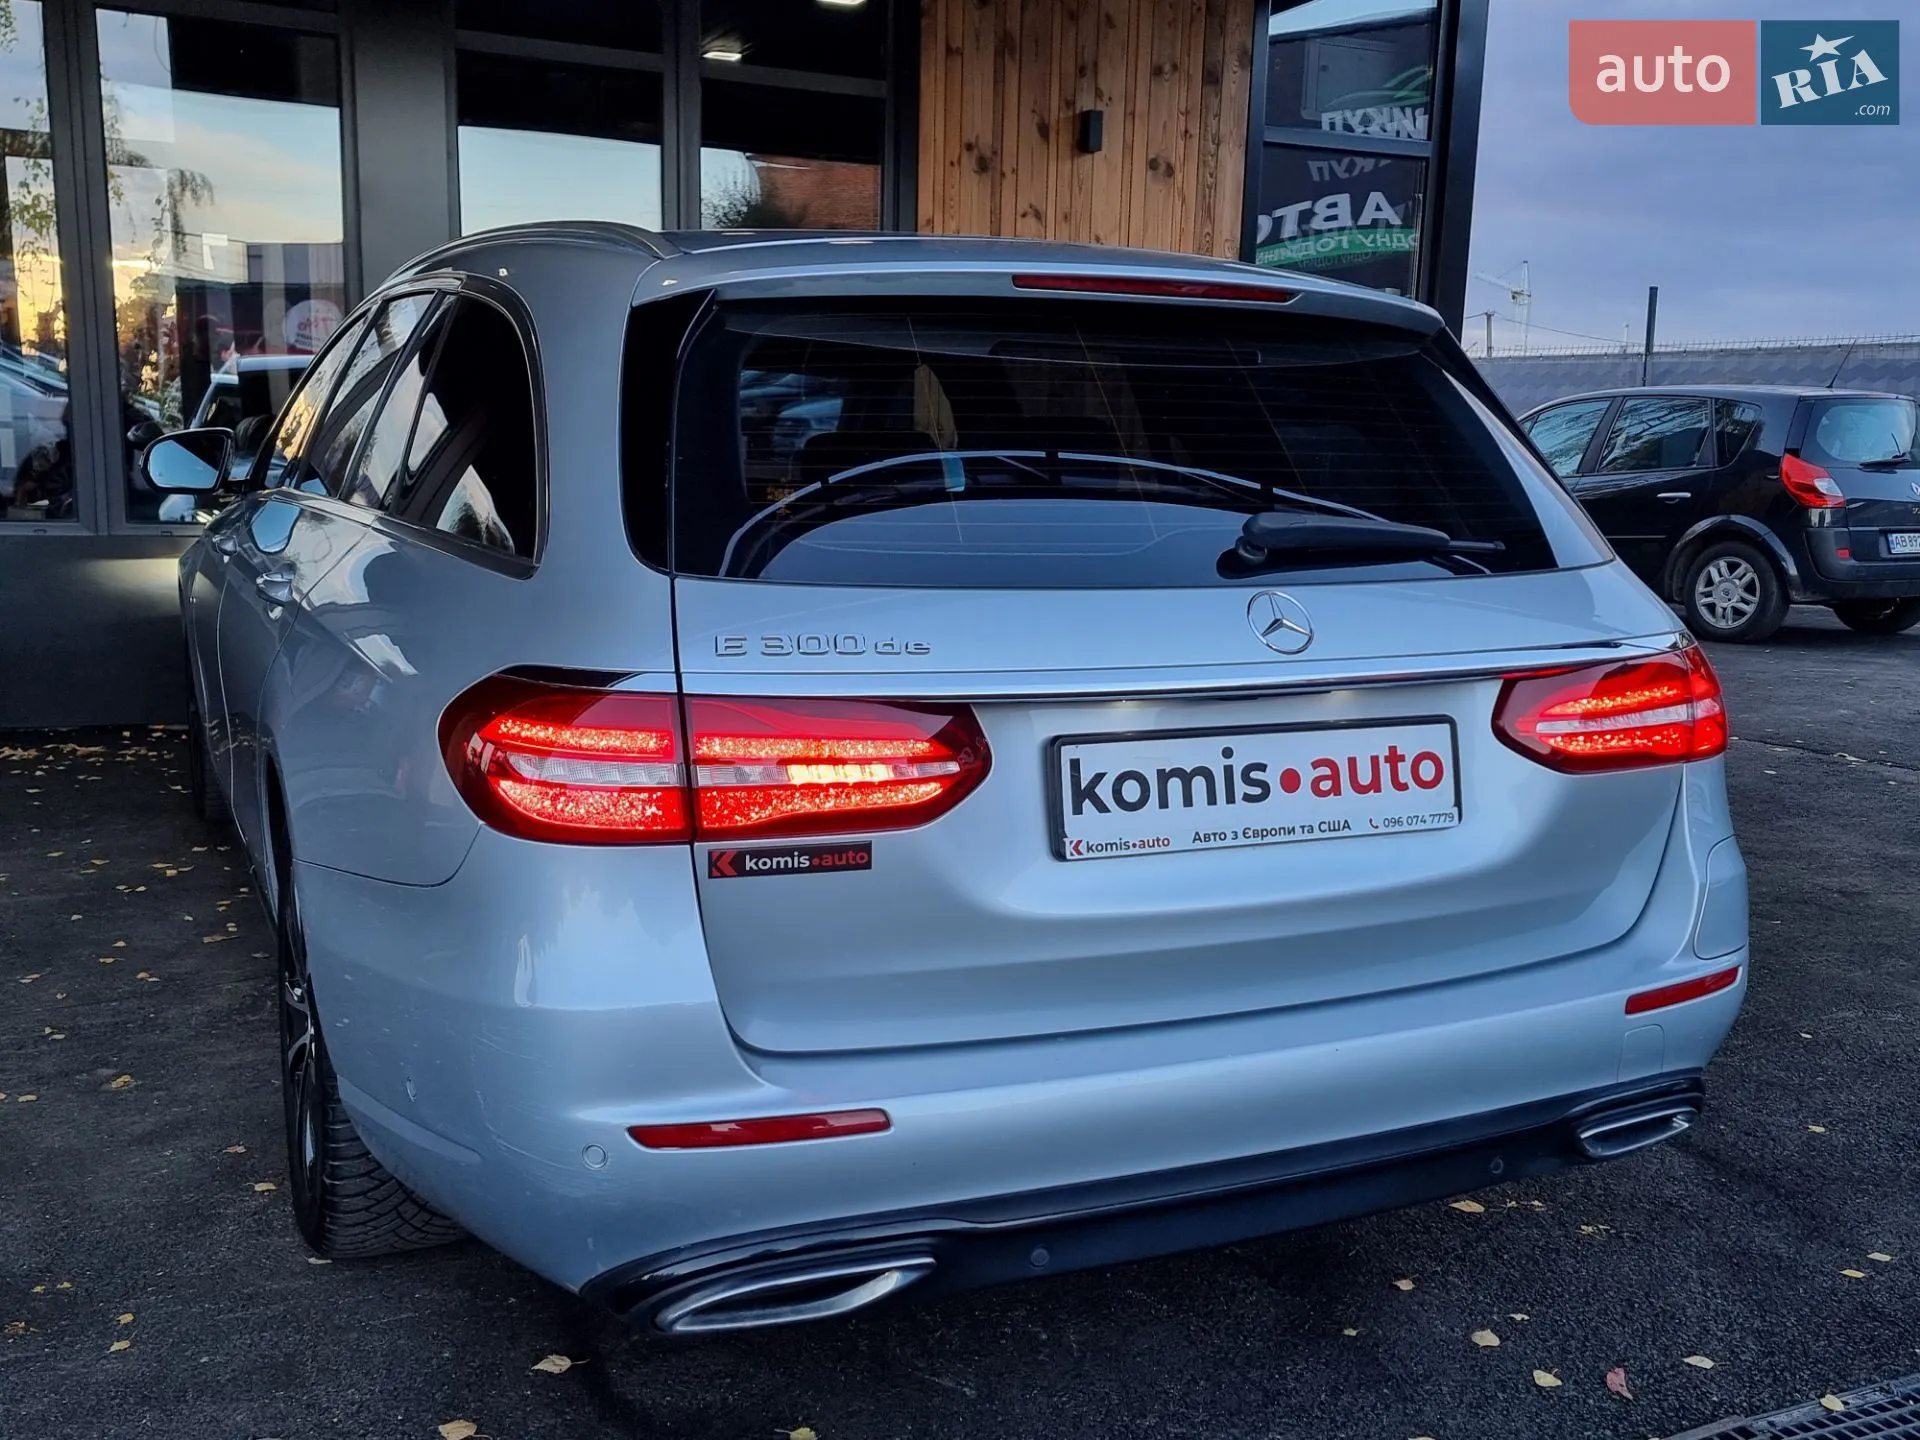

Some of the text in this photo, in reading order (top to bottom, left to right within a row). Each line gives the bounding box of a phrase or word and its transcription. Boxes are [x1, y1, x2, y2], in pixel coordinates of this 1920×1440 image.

[714, 633, 931, 656] E 300 de
[1192, 830, 1227, 844] Авто
[1242, 825, 1296, 839] Європи
[1299, 824, 1314, 835] та
[1318, 819, 1351, 833] США
[1383, 816, 1403, 829] 096
[1406, 814, 1427, 827] 074
